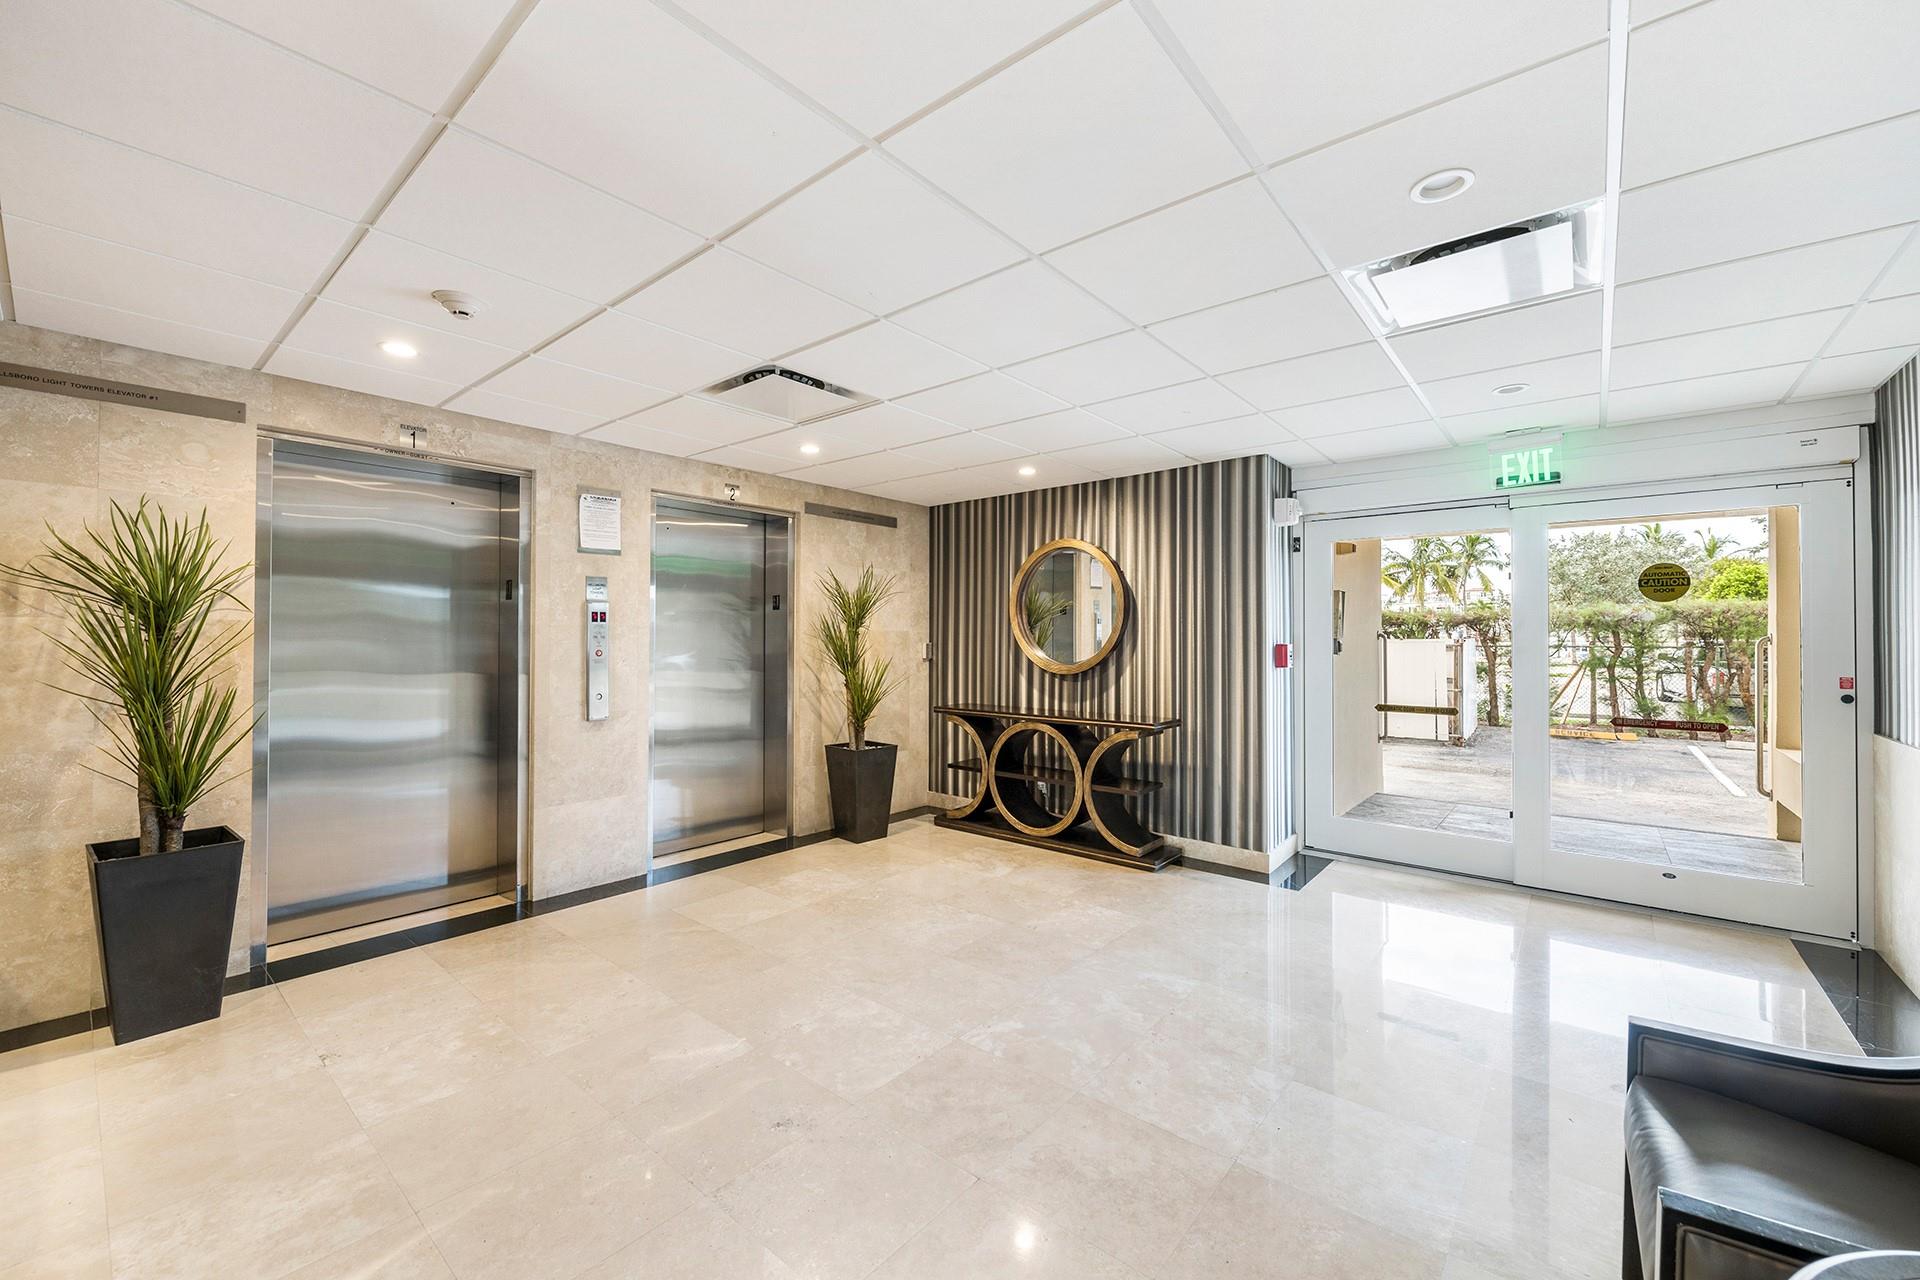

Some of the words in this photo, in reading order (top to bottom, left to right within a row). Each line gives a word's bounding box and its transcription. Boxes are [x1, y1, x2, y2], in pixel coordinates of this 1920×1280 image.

[42, 377, 67, 386] LIGHT
[70, 382, 105, 393] TOWERS
[107, 388, 147, 399] ELEVATOR
[400, 424, 427, 433] ELEVATOR
[410, 431, 416, 449] 1
[1501, 447, 1553, 487] EXIT
[729, 487, 736, 501] 2
[1641, 578, 1688, 587] CAUTION
[1675, 720, 1692, 729] PUSH
